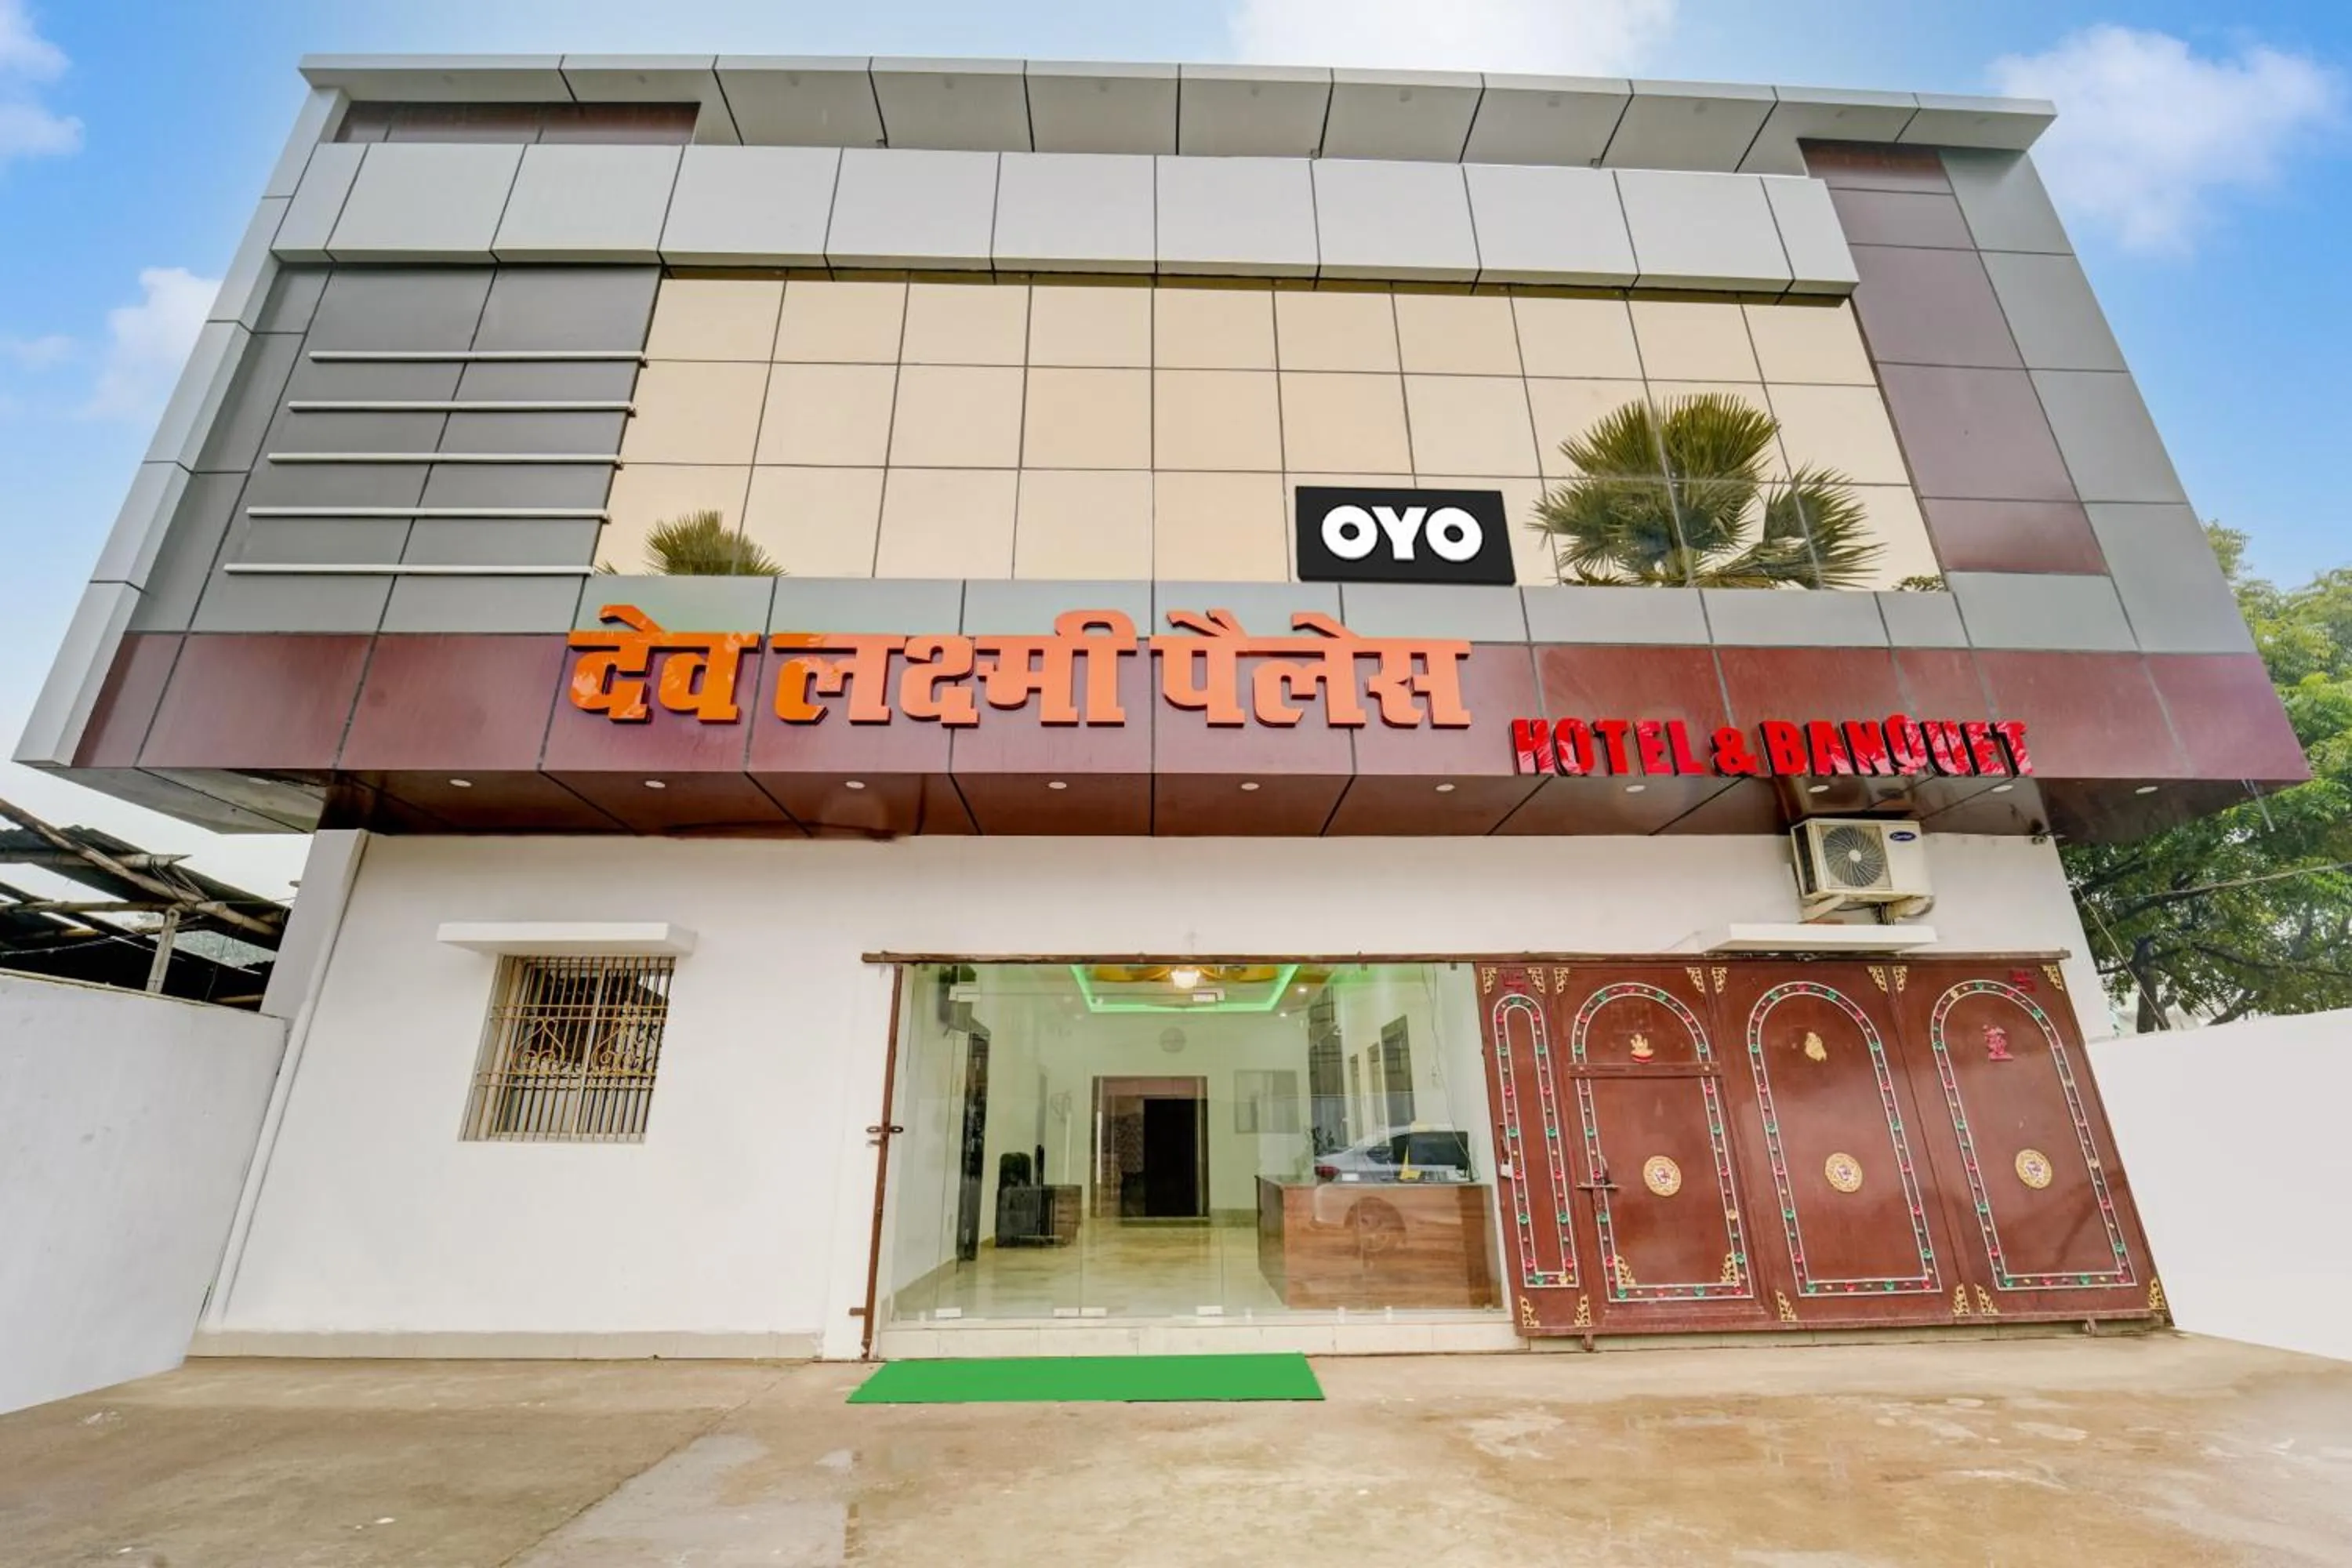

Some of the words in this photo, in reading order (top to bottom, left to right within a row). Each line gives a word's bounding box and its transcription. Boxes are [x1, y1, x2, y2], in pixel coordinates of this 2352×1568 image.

[1321, 505, 1483, 561] OYO
[567, 604, 760, 723] देव
[1150, 610, 1472, 728] पैलेस
[1510, 717, 1704, 777] HOTEL
[1710, 727, 1758, 776] &
[1759, 714, 2034, 777] BANQUET
